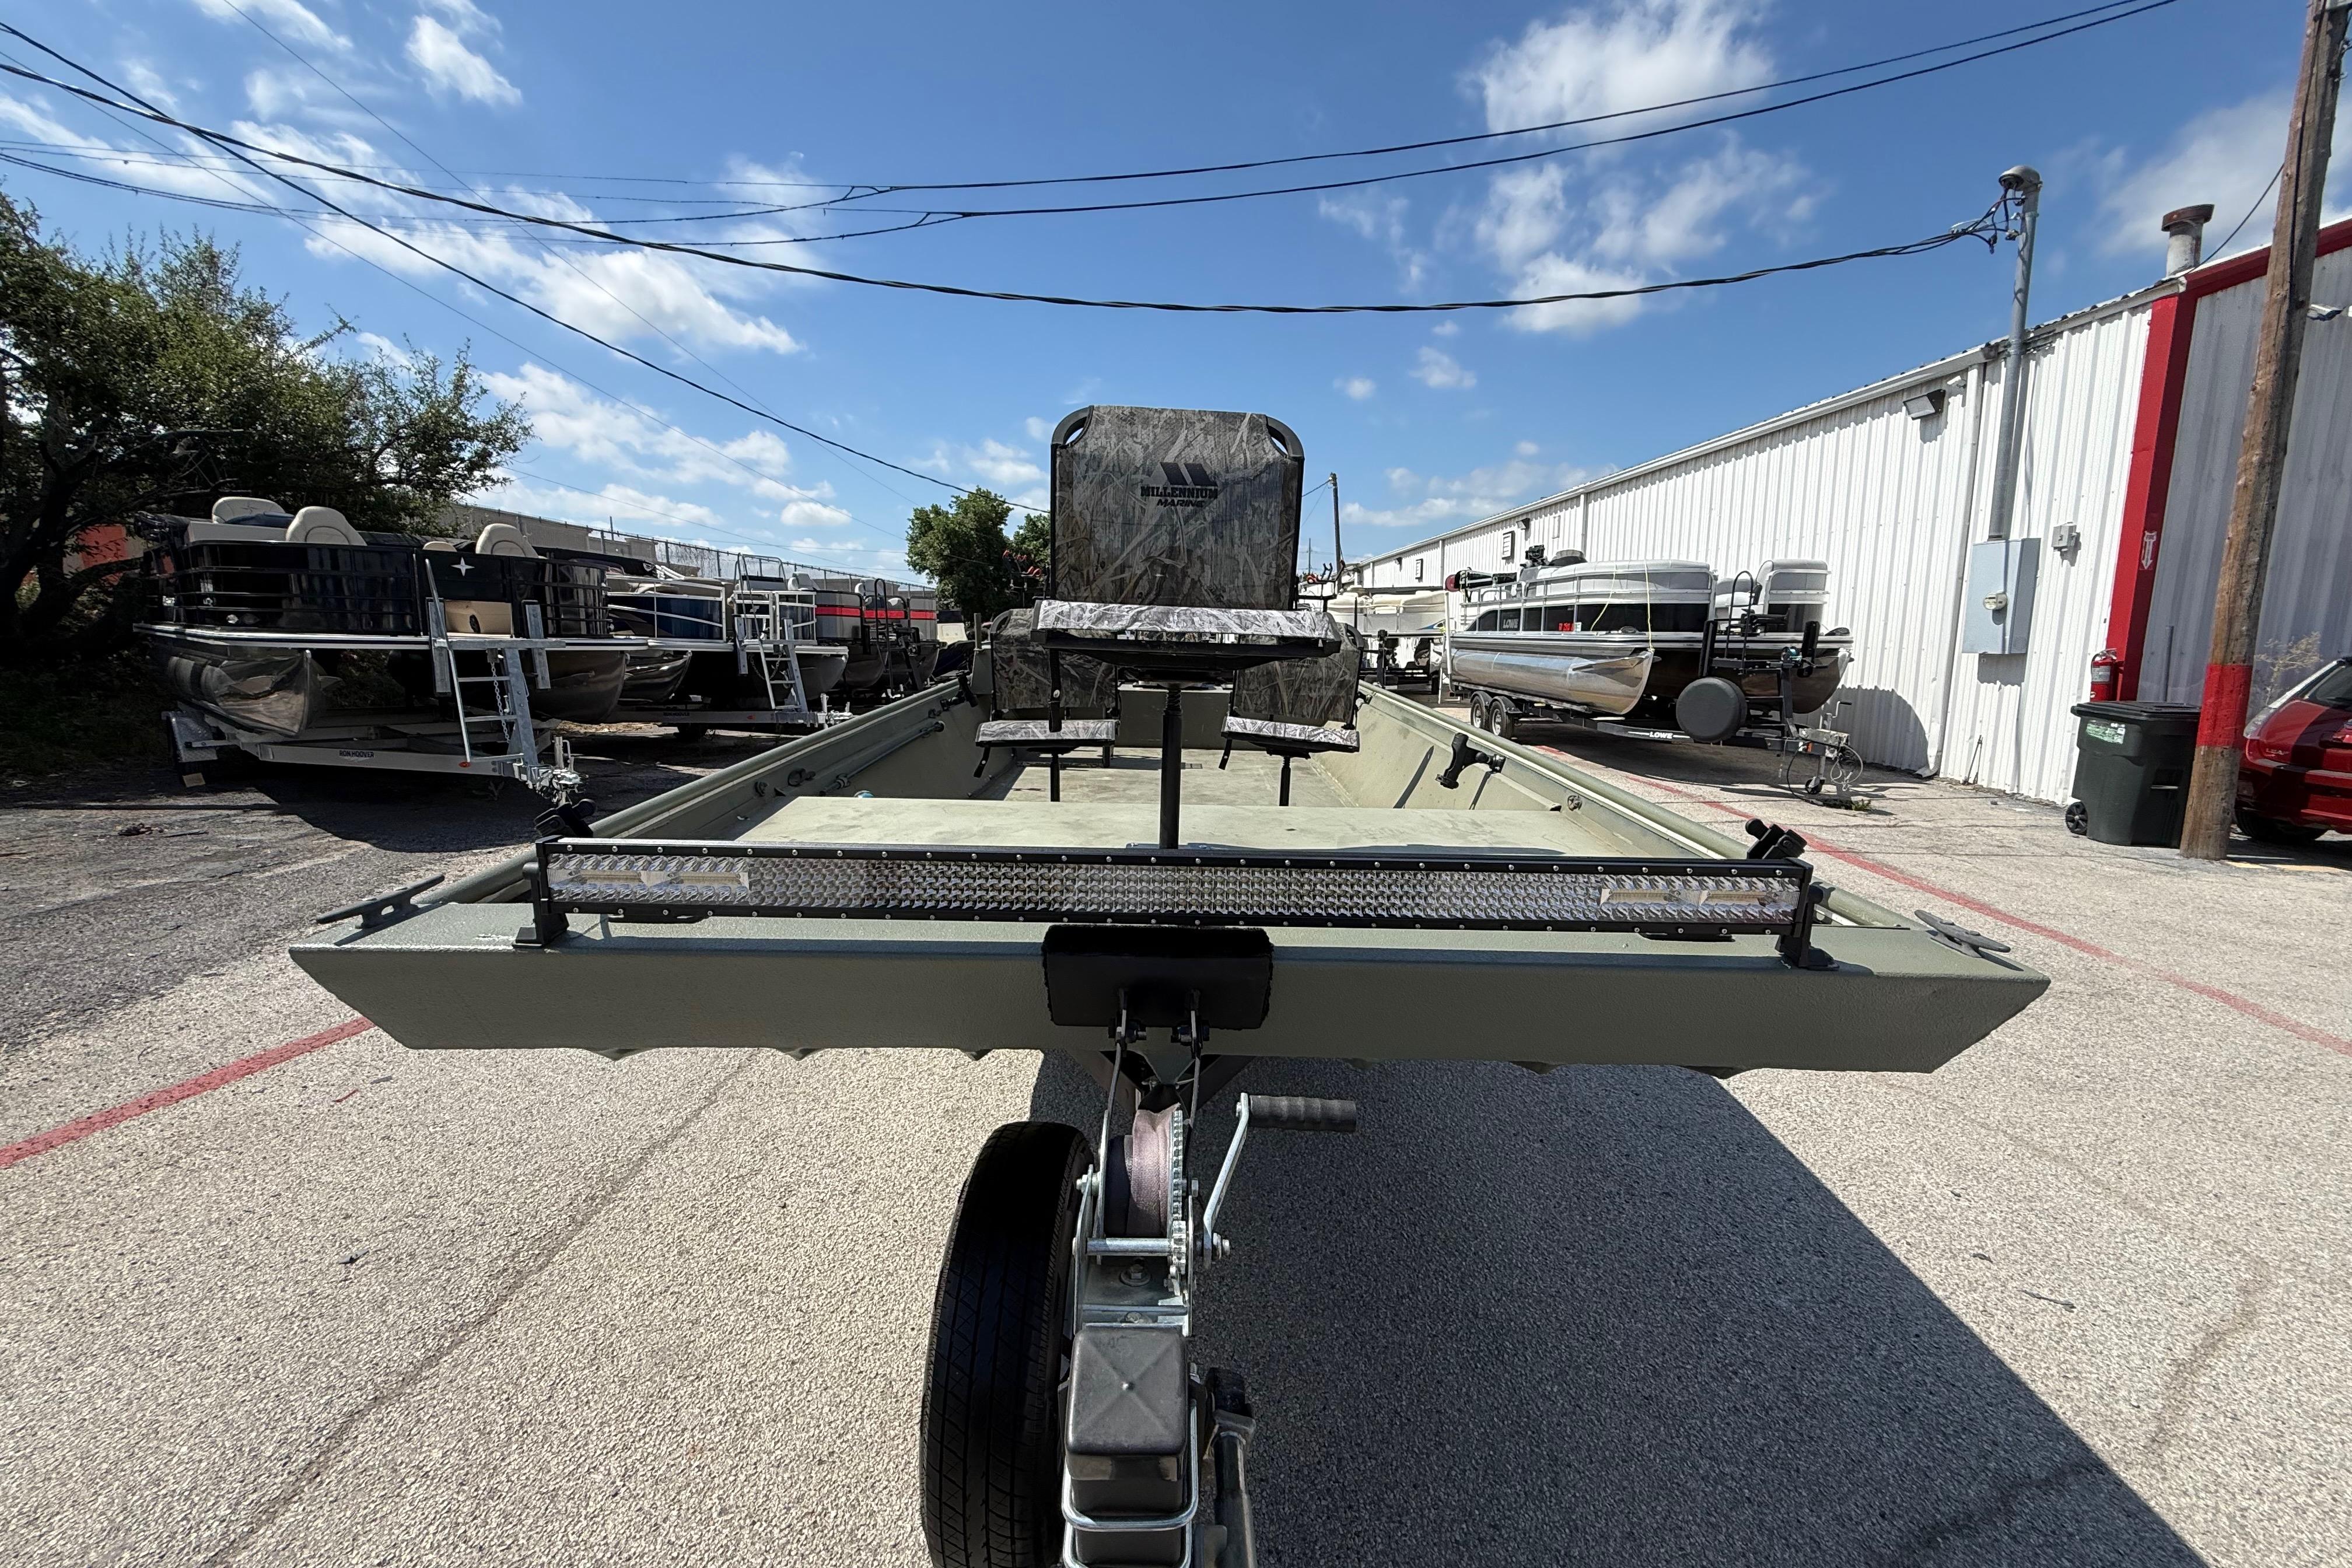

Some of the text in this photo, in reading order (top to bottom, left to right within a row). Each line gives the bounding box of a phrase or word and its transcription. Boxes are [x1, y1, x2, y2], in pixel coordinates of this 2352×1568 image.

[1140, 485, 1218, 499] MILLENNIUM
[1157, 499, 1206, 508] MARINE
[1503, 618, 1518, 629] LOWE
